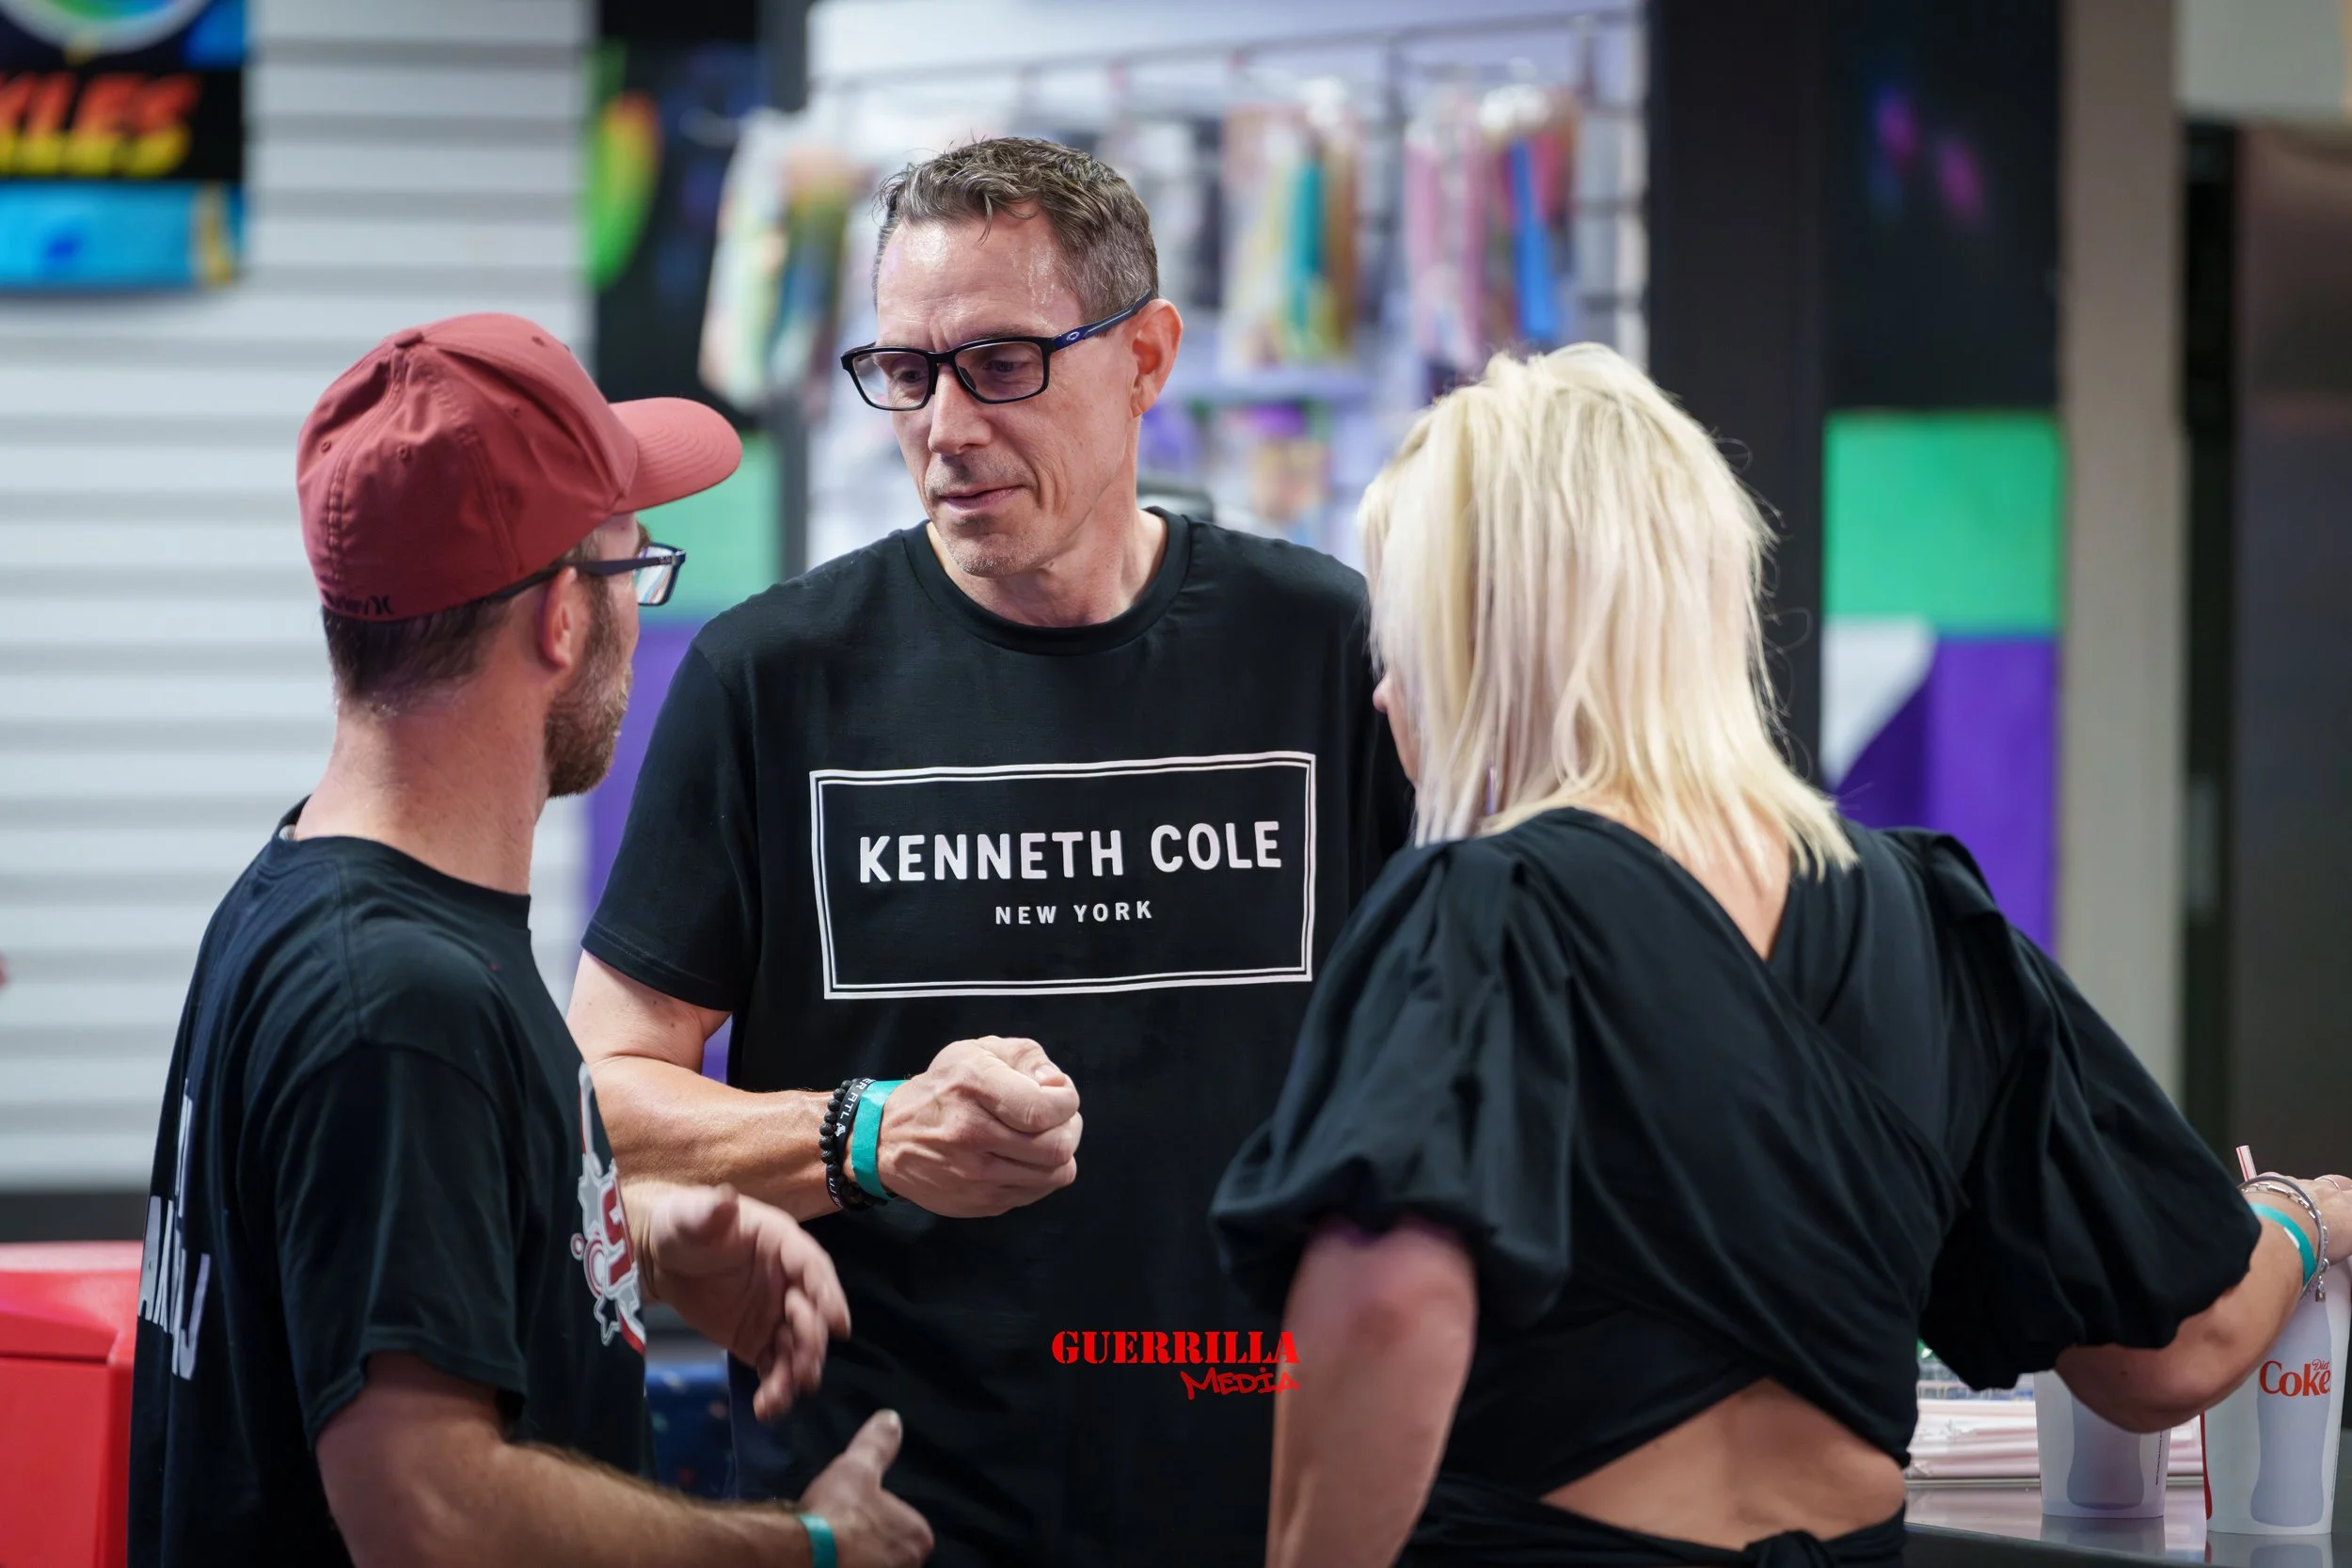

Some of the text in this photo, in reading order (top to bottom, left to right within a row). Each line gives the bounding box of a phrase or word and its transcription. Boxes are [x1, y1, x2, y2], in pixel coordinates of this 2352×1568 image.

[859, 820, 1282, 883] KENNETH COLE
[995, 900, 1152, 925] NEW YORK
[840, 1092, 859, 1119] ATL
[2312, 1358, 2330, 1371] Diet
[2259, 1360, 2331, 1397] Coke
